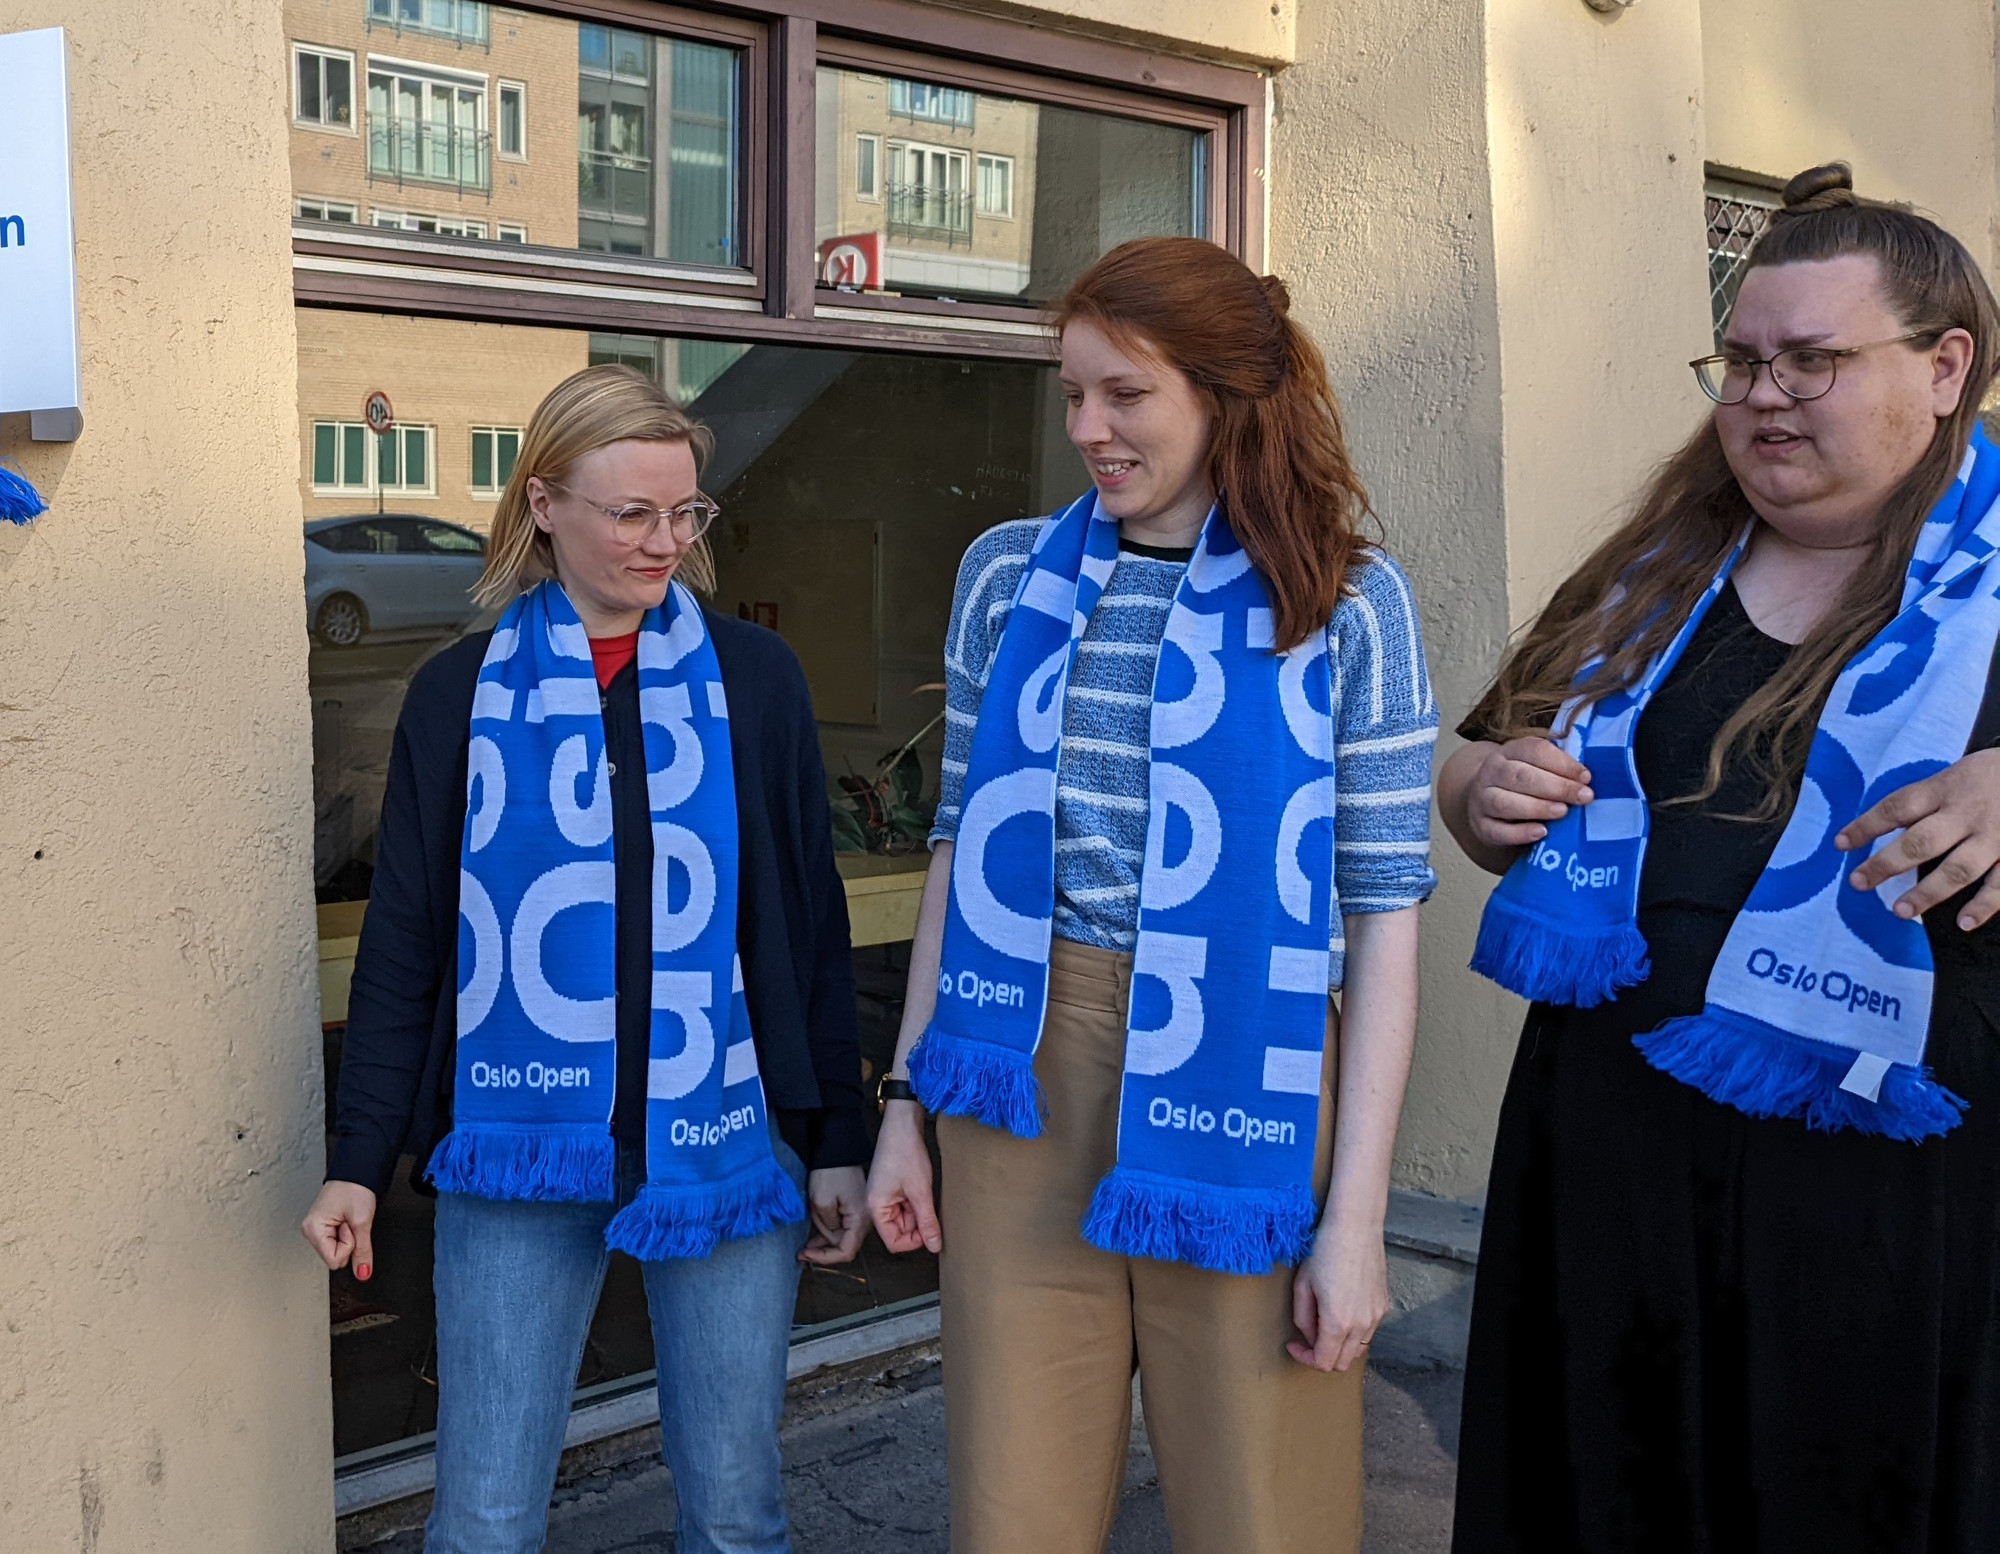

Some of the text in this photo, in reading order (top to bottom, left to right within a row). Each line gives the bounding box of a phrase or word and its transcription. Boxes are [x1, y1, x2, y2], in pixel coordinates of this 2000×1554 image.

[957, 970, 1025, 1008] Open
[1747, 948, 1902, 1021] Oslo Open
[470, 1061, 590, 1094] Oslo Open
[671, 1118, 720, 1146] Oslo
[1148, 1097, 1296, 1147] Oslo Open
